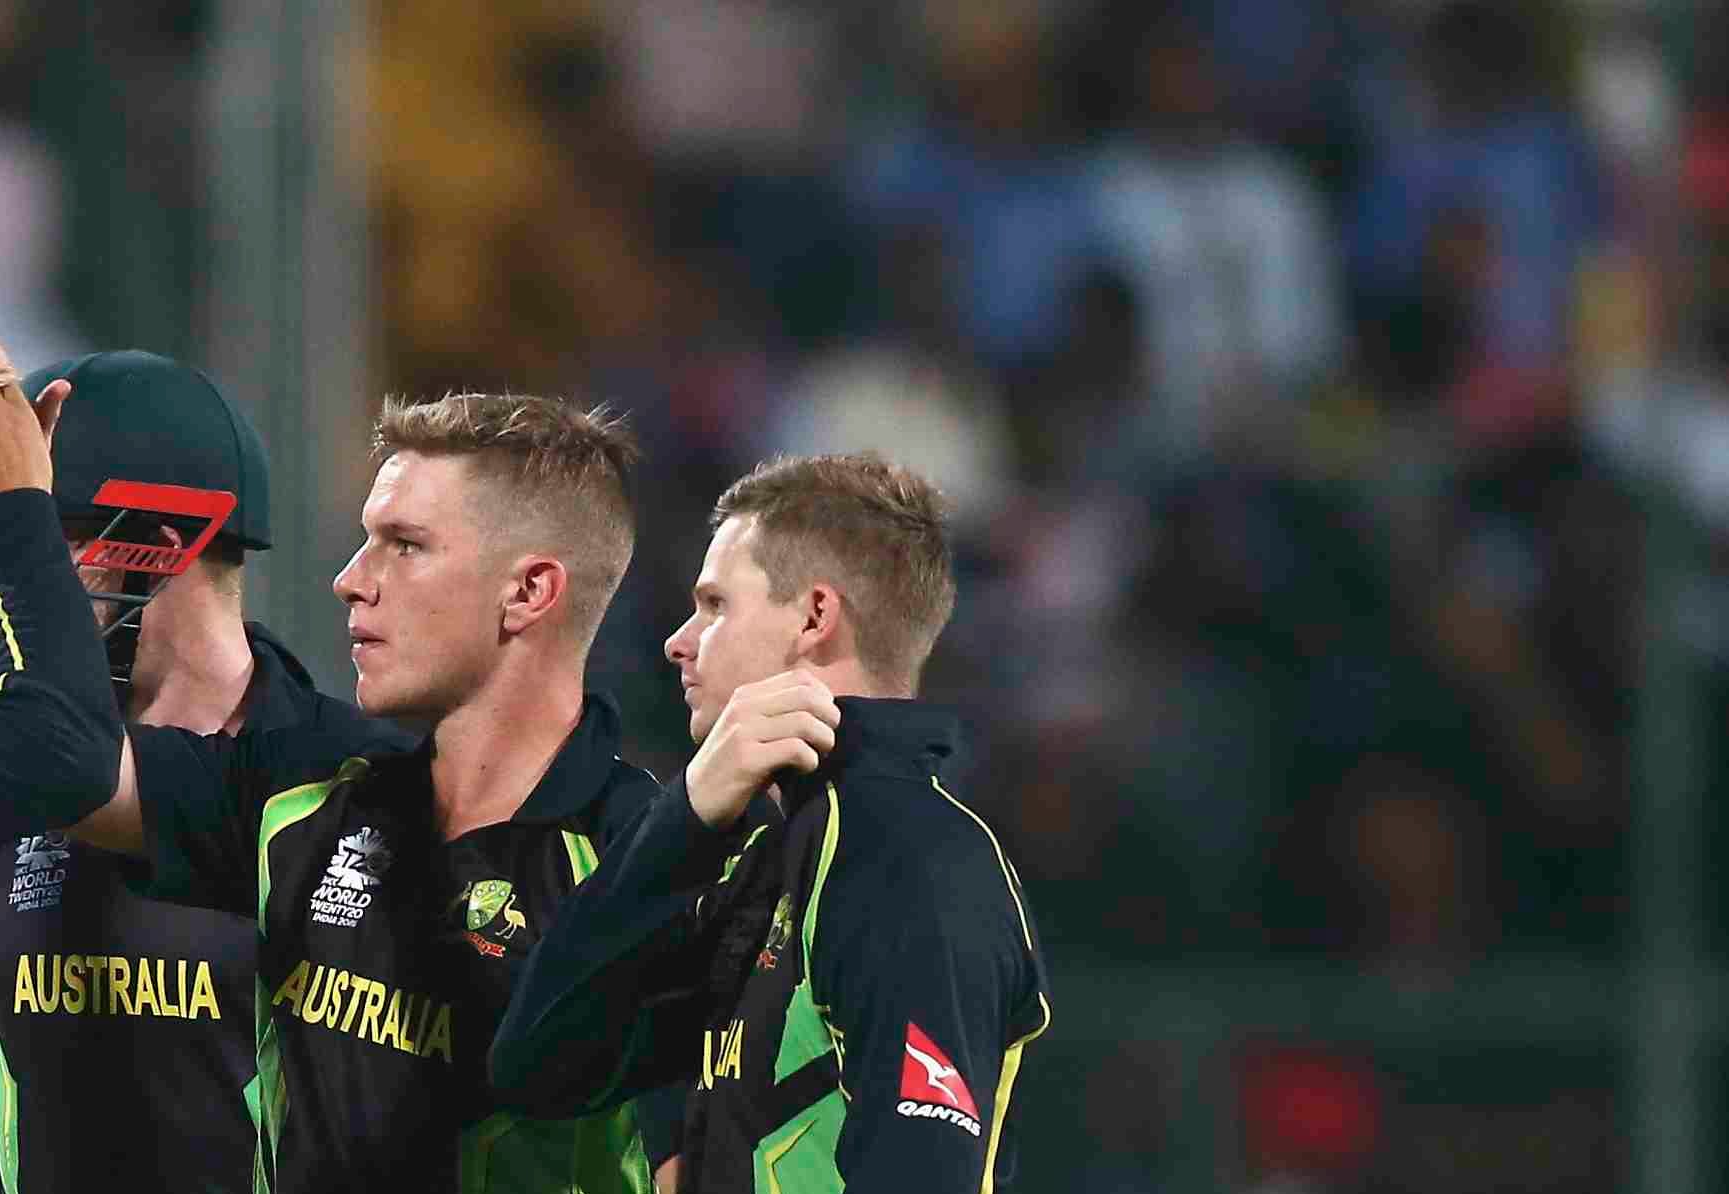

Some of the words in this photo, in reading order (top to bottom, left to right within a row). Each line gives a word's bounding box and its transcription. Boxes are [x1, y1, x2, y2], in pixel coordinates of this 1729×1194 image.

[12, 868, 68, 893] WORLD
[310, 898, 364, 919] TWENTY20
[312, 884, 372, 908] WORLD
[13, 953, 222, 1020] AUSTRALIA
[272, 959, 452, 1064] AUSTRALIA
[896, 1101, 982, 1137] QANTAS
